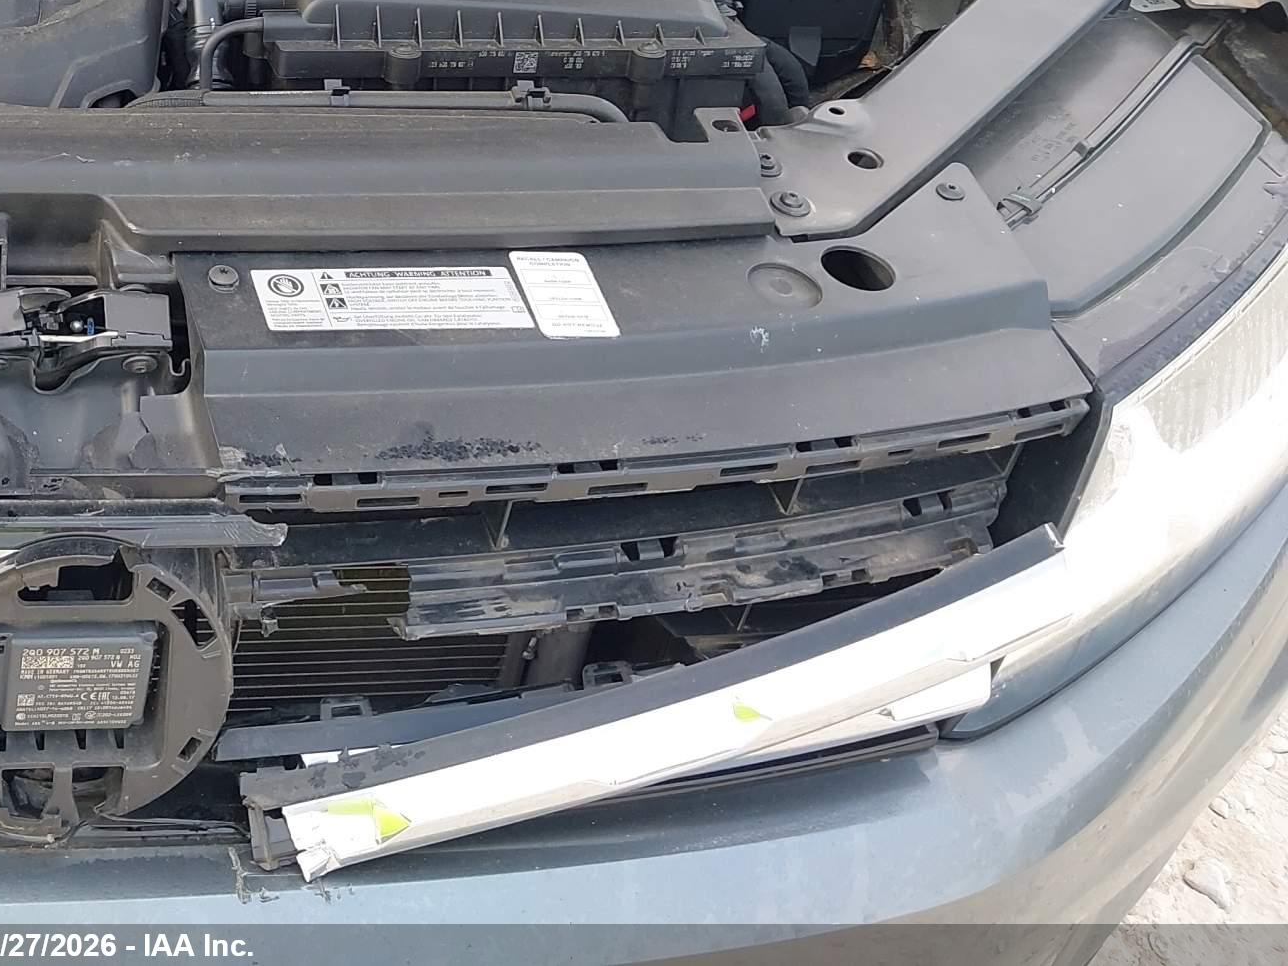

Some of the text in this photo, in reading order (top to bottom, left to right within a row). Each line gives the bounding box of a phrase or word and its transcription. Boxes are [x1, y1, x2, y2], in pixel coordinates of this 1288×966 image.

[46, 648, 65, 656] 907
[70, 648, 90, 656] 572
[93, 647, 100, 655] M
